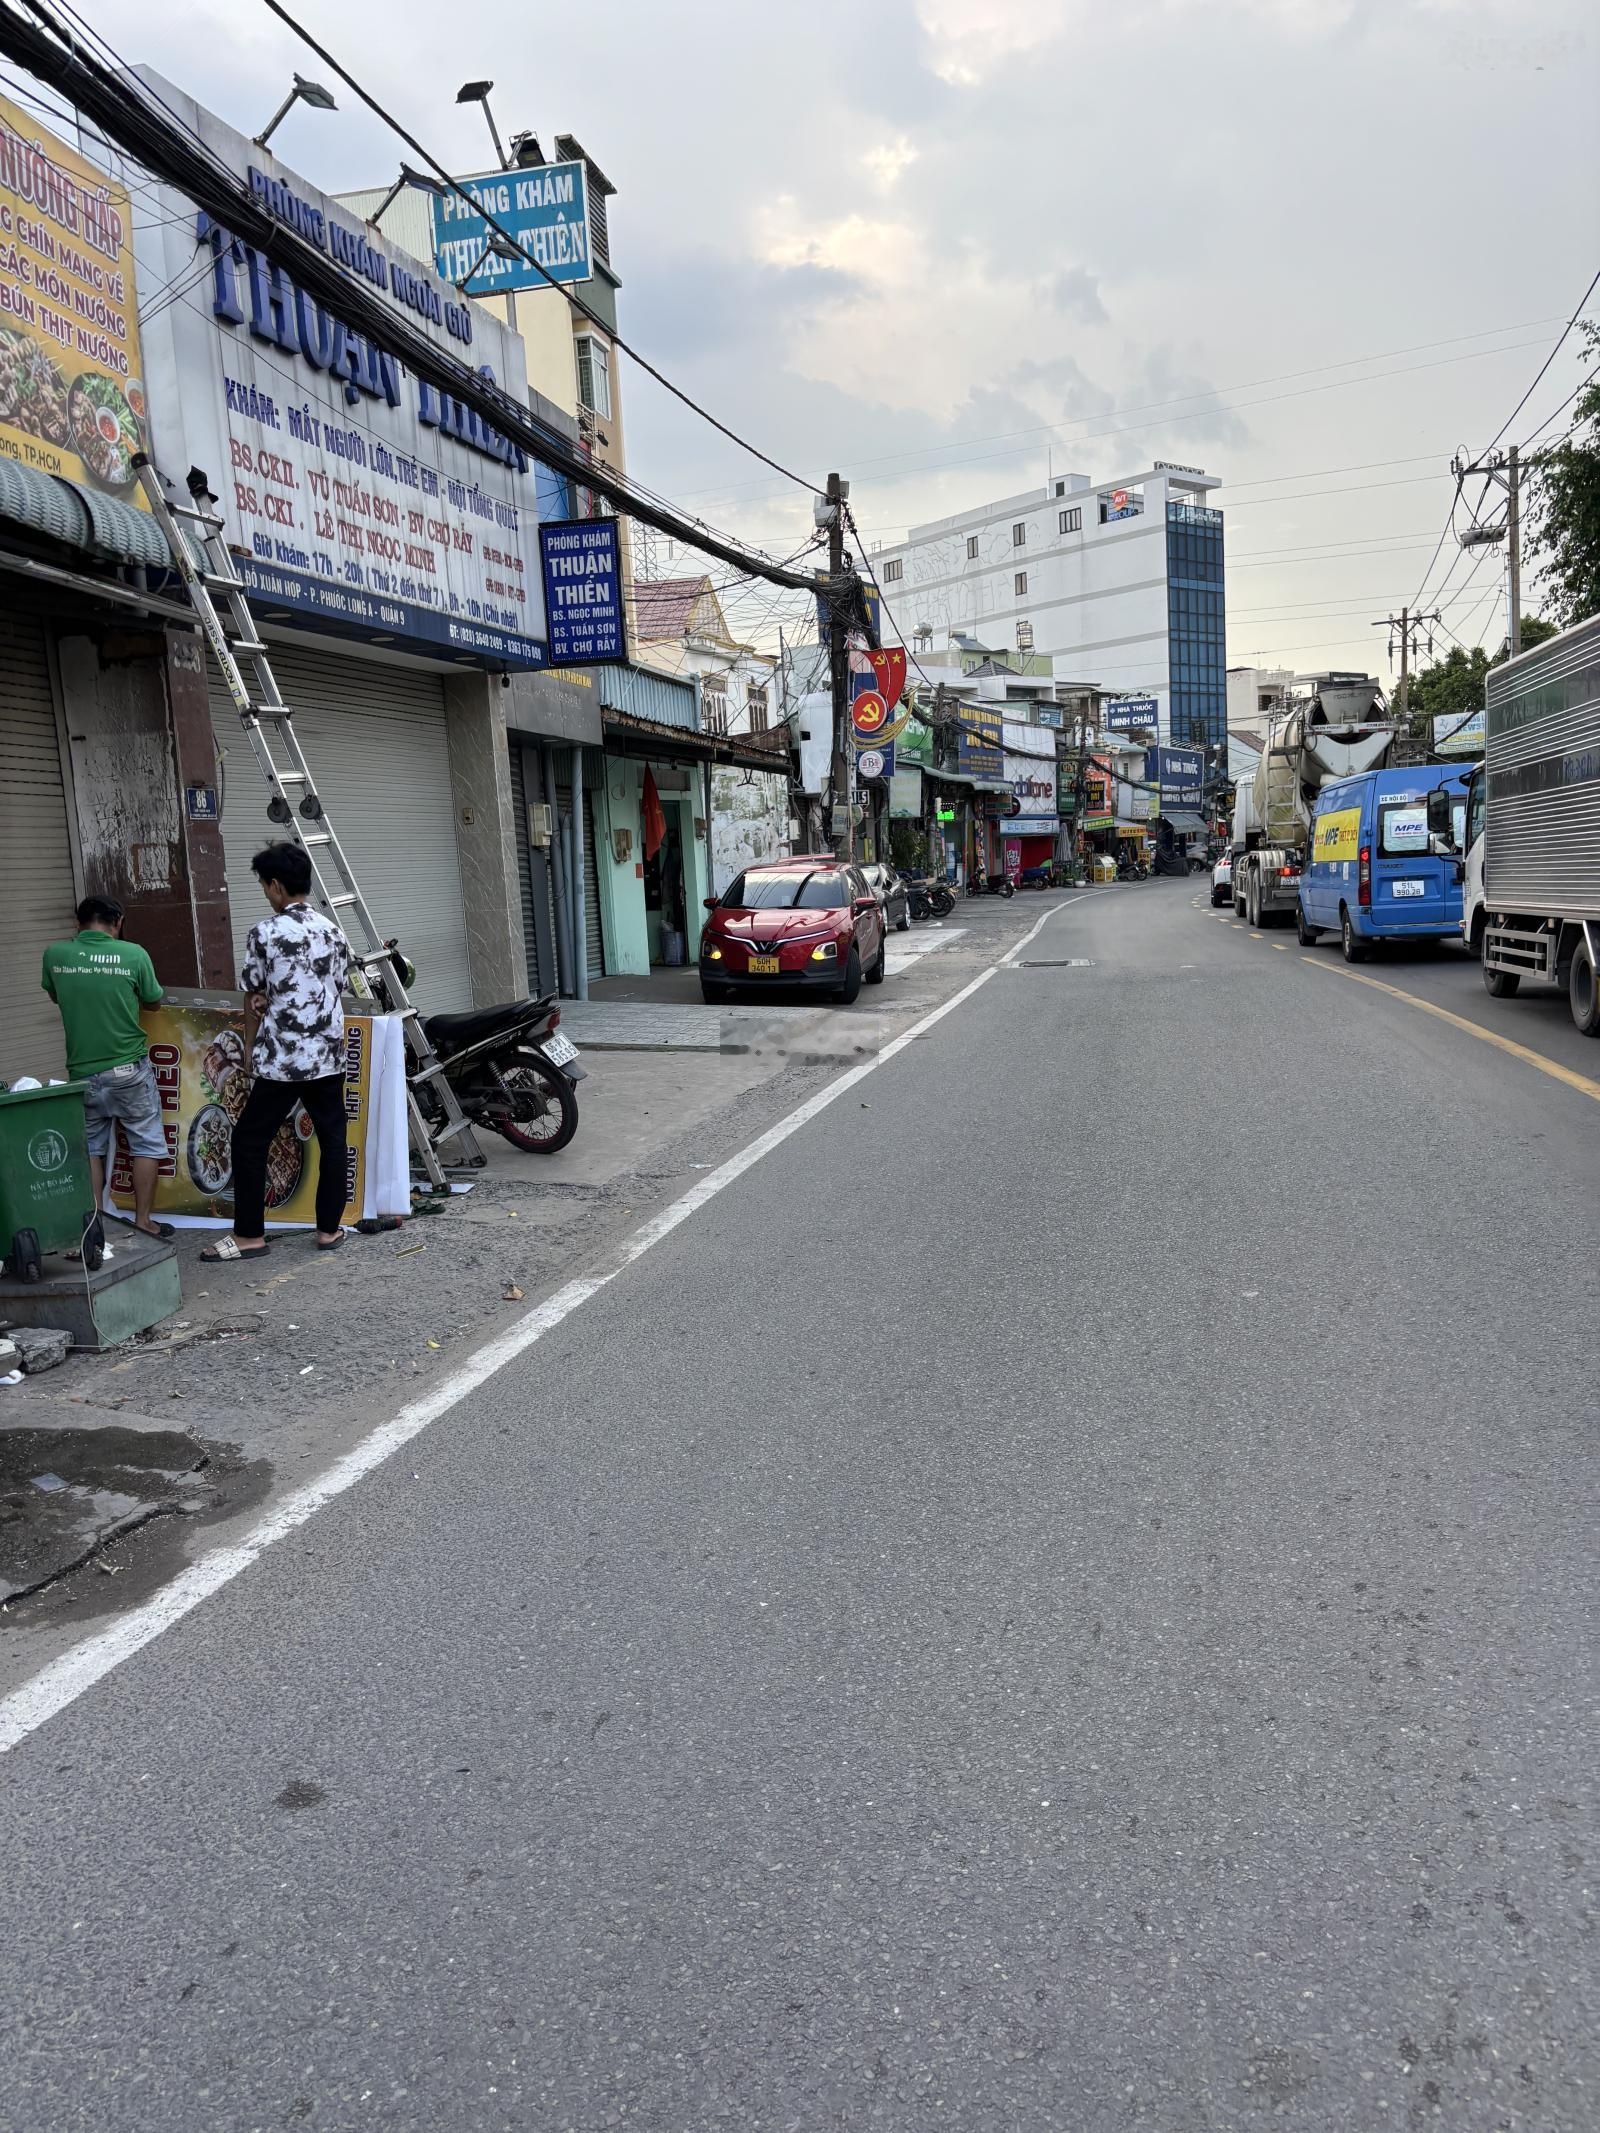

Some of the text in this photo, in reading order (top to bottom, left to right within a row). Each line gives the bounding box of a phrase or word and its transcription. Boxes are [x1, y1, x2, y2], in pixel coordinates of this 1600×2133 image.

[443, 170, 573, 222] PHÒNG KHÁM
[81, 184, 123, 262] HẤP
[517, 210, 586, 271] THIÊN
[16, 216, 55, 261] CHÍN
[59, 241, 103, 291] MANG
[105, 271, 124, 306] VỀ
[329, 221, 388, 290] KHÁM
[390, 262, 443, 326] NGOÀI
[445, 302, 472, 345] GIỜ
[0, 243, 127, 341] CÁC MÓN NƯỚNG
[0, 282, 129, 377] BÚN THỊT NƯỚNG
[224, 376, 281, 431] KHÁM:
[287, 403, 321, 448] MẮT
[323, 422, 367, 468] NGƯỜI
[421, 466, 440, 499] EM
[314, 508, 335, 541] LÊ
[337, 519, 366, 557] THỊ
[366, 529, 402, 567] NGỌC
[403, 542, 437, 574] MINH
[333, 479, 371, 517] TUẤN
[374, 495, 400, 528] SƠN
[408, 510, 425, 537] BV
[427, 518, 451, 553] CHỢ
[547, 530, 611, 552] PHÒNG KHÁM
[253, 530, 273, 560] Giờ
[275, 538, 311, 570] khám:
[312, 550, 333, 577] 17h
[344, 559, 364, 586] 20h
[549, 550, 613, 579] THUẬN
[259, 573, 284, 596] XUÂN
[320, 589, 347, 612] PHƯỚC
[348, 601, 367, 616] LONG
[552, 606, 615, 621] BS. NGỌC MINH
[555, 580, 610, 606] THIÊN
[553, 621, 616, 638] BS. TUẤN SƠN
[572, 639, 593, 655] CHỢ
[596, 634, 616, 652] RẪY
[1111, 713, 1154, 727] MINH CHÂU
[1117, 703, 1153, 713] NHÀ THUỐC
[1394, 823, 1424, 833] MPE
